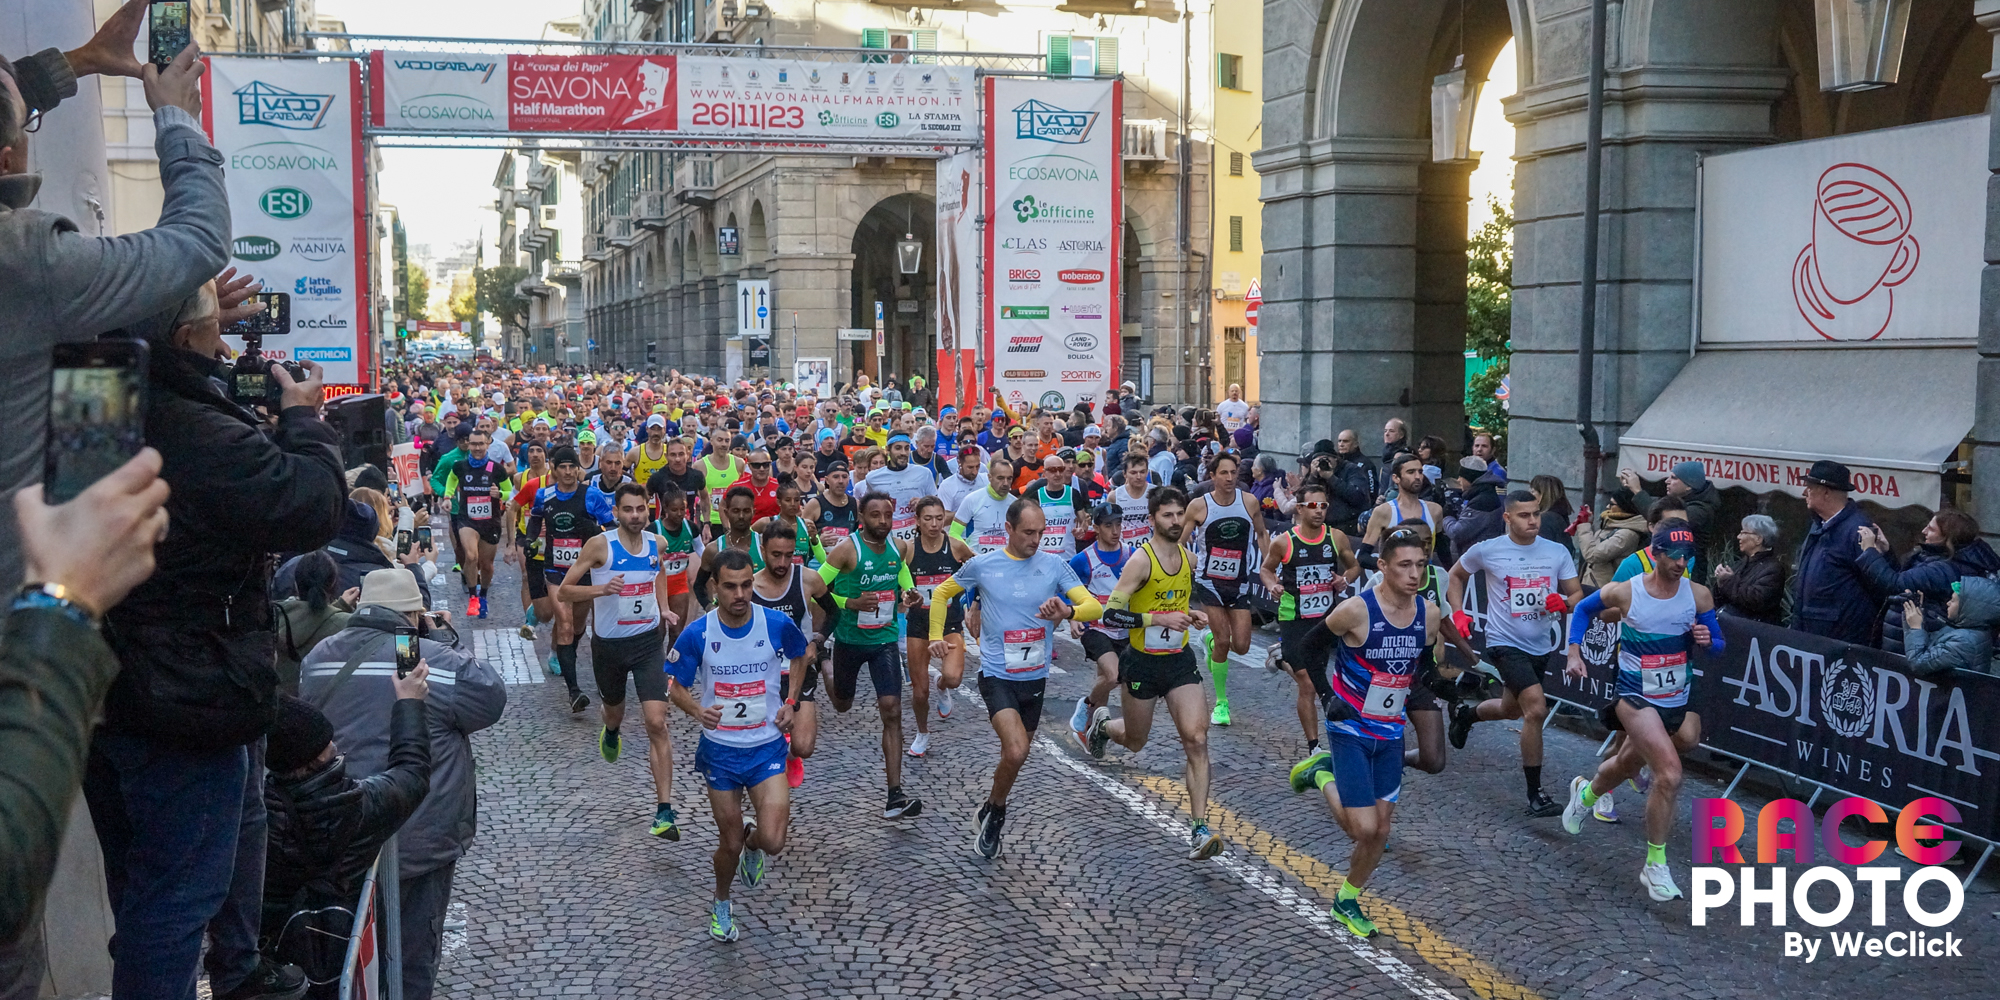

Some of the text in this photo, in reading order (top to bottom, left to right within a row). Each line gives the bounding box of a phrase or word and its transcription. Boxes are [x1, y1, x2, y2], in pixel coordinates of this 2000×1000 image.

[437, 61, 490, 72] GATEWAY
[513, 61, 525, 72] La
[563, 62, 579, 73] dei
[513, 76, 632, 100] SAVONA
[689, 89, 963, 107] WWW.SAVONAHALFMARATHON.IT
[400, 105, 495, 121] ECOSAVONA
[513, 102, 606, 117] Half Marathon
[262, 112, 317, 121] GATEWAY
[835, 117, 868, 125] officine
[879, 114, 897, 126] ESI
[924, 113, 961, 121] STAMPA
[921, 123, 928, 131] IL
[928, 123, 950, 131] SECOLO
[1036, 128, 1083, 136] GATEWAY
[231, 155, 338, 171] ECOSAVONA
[1009, 167, 1099, 182] ECOSAVONA
[267, 192, 304, 215] ESI
[1039, 200, 1047, 208] le
[1041, 206, 1094, 219] officine
[231, 241, 275, 255] Alberti
[290, 243, 346, 254] MANIVA
[1005, 238, 1047, 250] CLAS
[1059, 240, 1103, 251] ASTORIA
[309, 277, 331, 286] latte
[1062, 271, 1100, 280] noberasco
[309, 286, 342, 296] tigullio
[1010, 335, 1044, 345] speed
[297, 350, 349, 359] DECATHLON
[1007, 344, 1041, 353] wheel
[1061, 370, 1102, 379] SPORTING
[1647, 453, 1780, 484] DEGTAZIONE
[470, 504, 489, 514] 498
[1043, 536, 1064, 547] 237
[556, 550, 579, 562] 304
[669, 560, 681, 571] 13
[1211, 559, 1236, 573] 254
[1155, 589, 1187, 600] SCOTTA
[633, 600, 643, 615] 5
[1303, 595, 1330, 610] 520
[1521, 613, 1538, 621] 303
[1160, 627, 1171, 642] 4
[1382, 635, 1417, 648] ATLETICA
[1021, 647, 1032, 661] 7
[1365, 648, 1394, 660] ROATA
[710, 661, 769, 676] ESERCITO
[1561, 669, 1614, 701] WINE
[1655, 670, 1677, 688] 14
[1383, 693, 1395, 709] 6
[734, 702, 748, 718] 2
[1796, 738, 1894, 790] WINES
